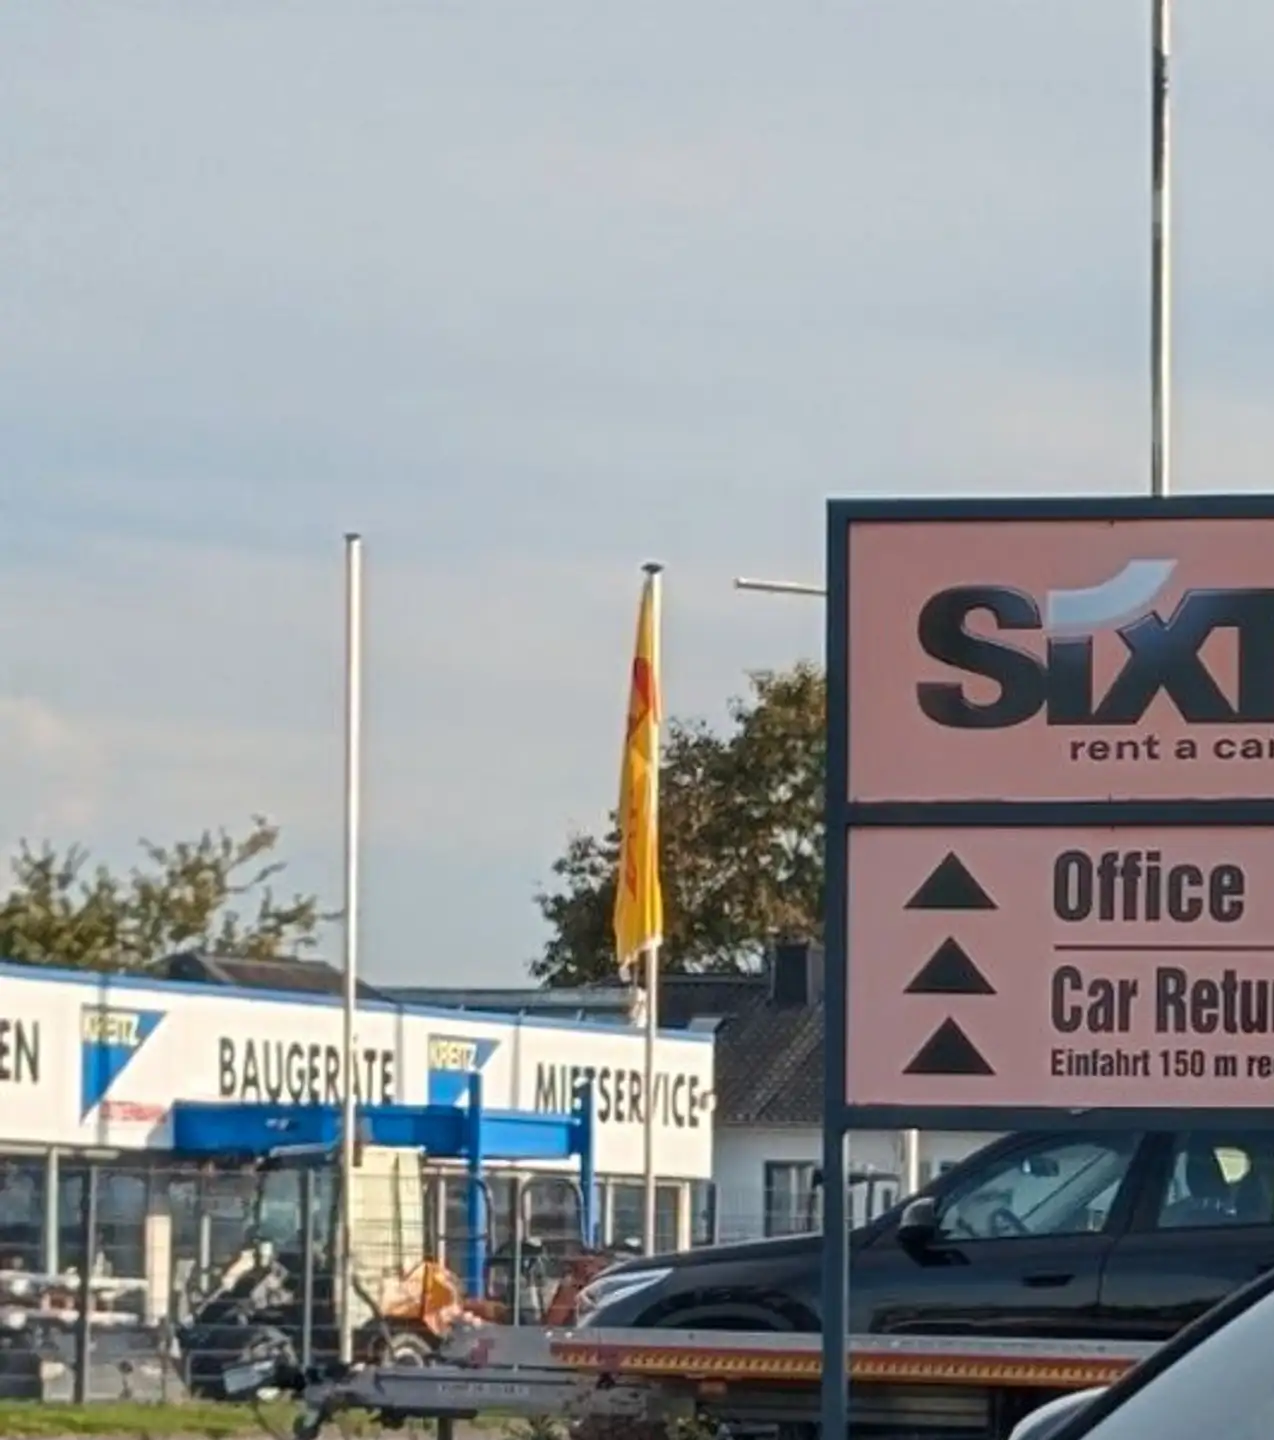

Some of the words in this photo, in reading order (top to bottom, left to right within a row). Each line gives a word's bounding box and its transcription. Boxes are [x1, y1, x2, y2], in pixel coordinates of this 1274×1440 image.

[1070, 734, 1159, 762] rent
[1174, 738, 1198, 761] a
[1052, 850, 1245, 923] Office
[1051, 966, 1138, 1034] Car
[1050, 1049, 1150, 1077] Einfahrt
[1159, 1050, 1206, 1077] 150
[1214, 1054, 1237, 1077] m
